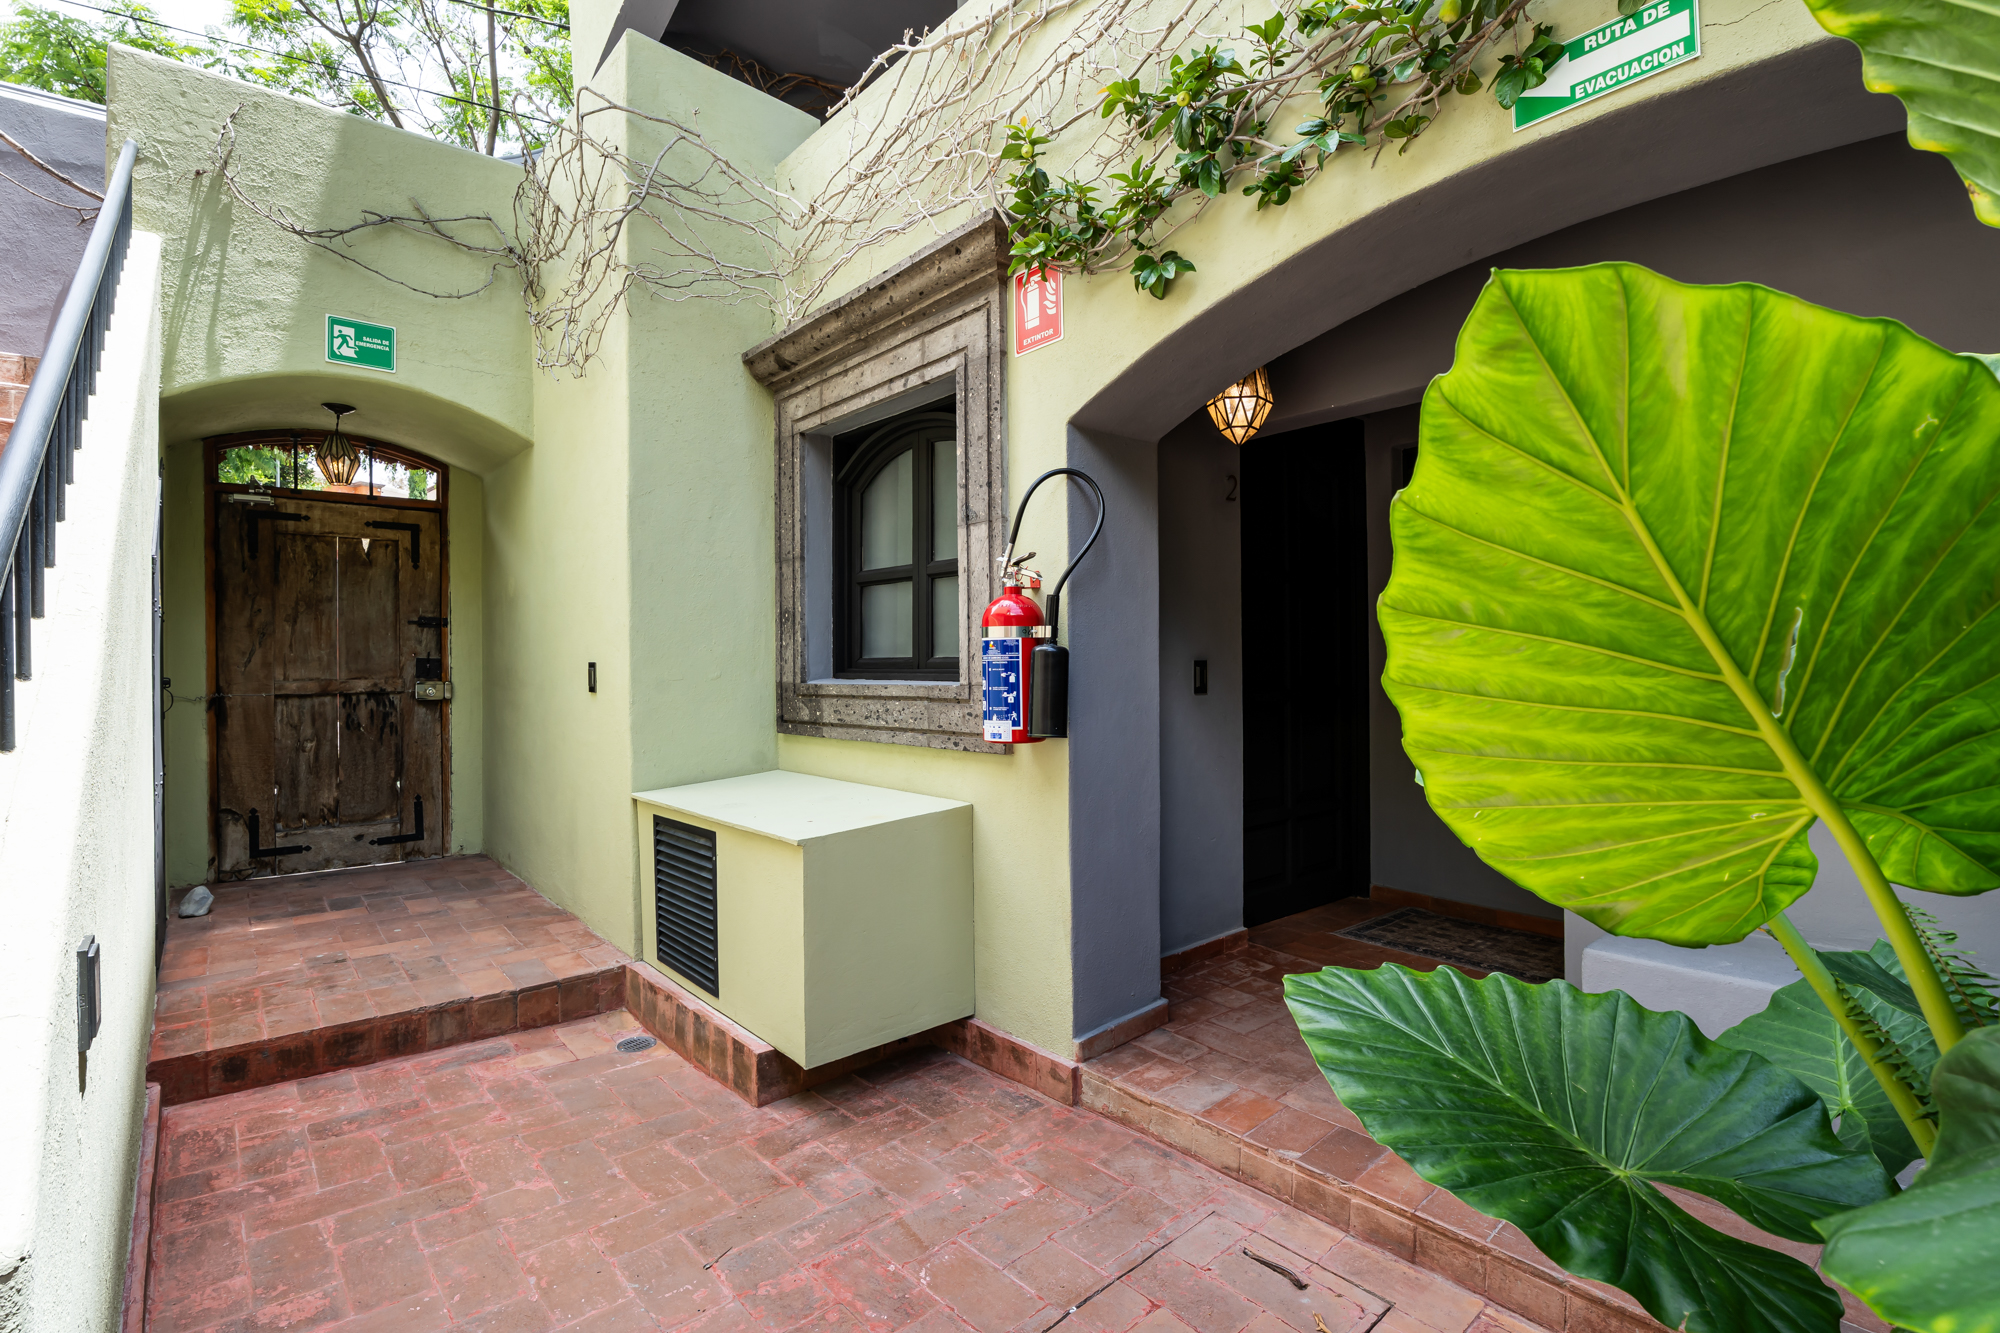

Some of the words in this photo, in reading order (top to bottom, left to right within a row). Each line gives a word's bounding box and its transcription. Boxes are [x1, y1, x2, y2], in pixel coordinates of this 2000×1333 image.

[1584, 18, 1637, 52] RUTA
[1643, 1, 1670, 24] DE
[1575, 41, 1685, 99] EVACUACION
[356, 341, 389, 351] EMERGENCIA
[363, 336, 381, 344] SALIDA
[1023, 328, 1053, 345] EXTINTOR
[1226, 474, 1237, 501] 2
